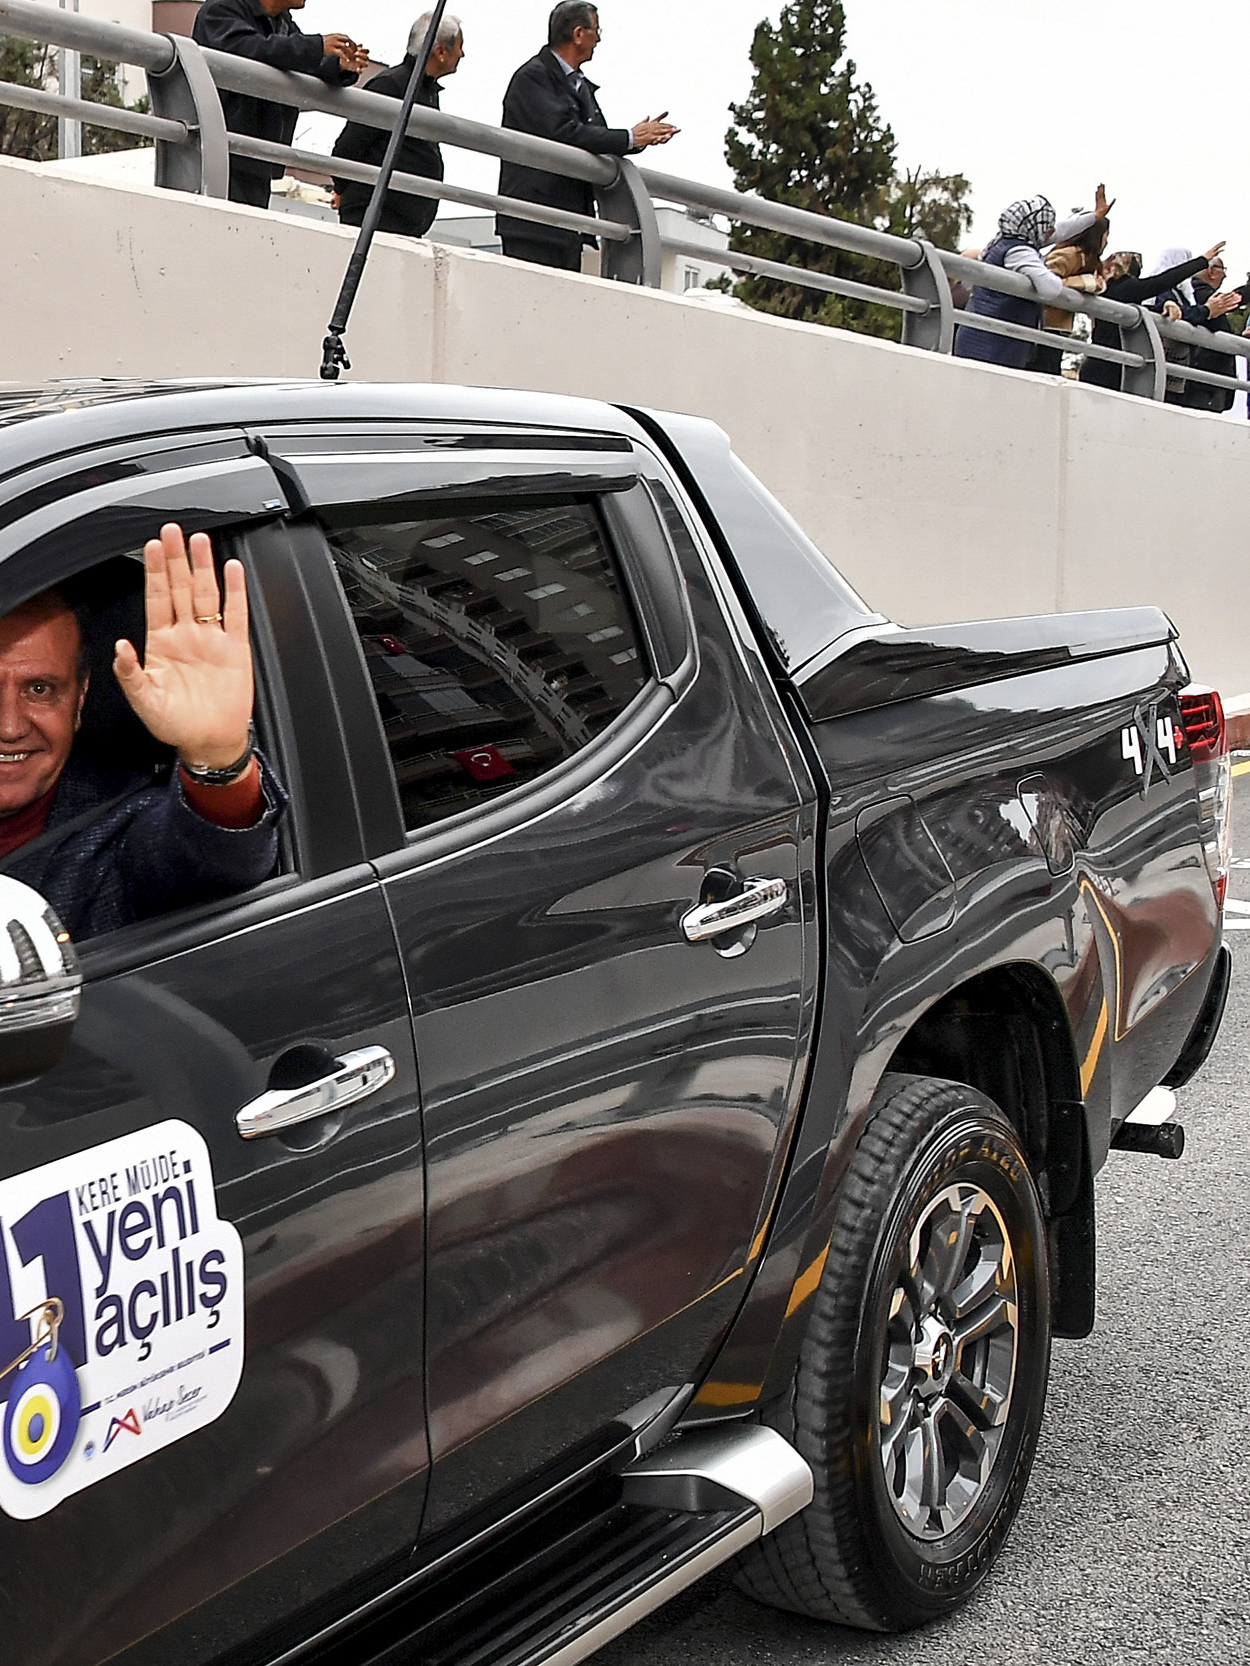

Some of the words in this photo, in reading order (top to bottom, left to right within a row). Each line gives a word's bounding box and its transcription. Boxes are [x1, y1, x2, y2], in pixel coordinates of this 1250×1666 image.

[75, 1172, 121, 1217] KERE
[125, 1150, 181, 1197] MÜJDE
[82, 1159, 200, 1294] yeni
[95, 1247, 228, 1361] açılış
